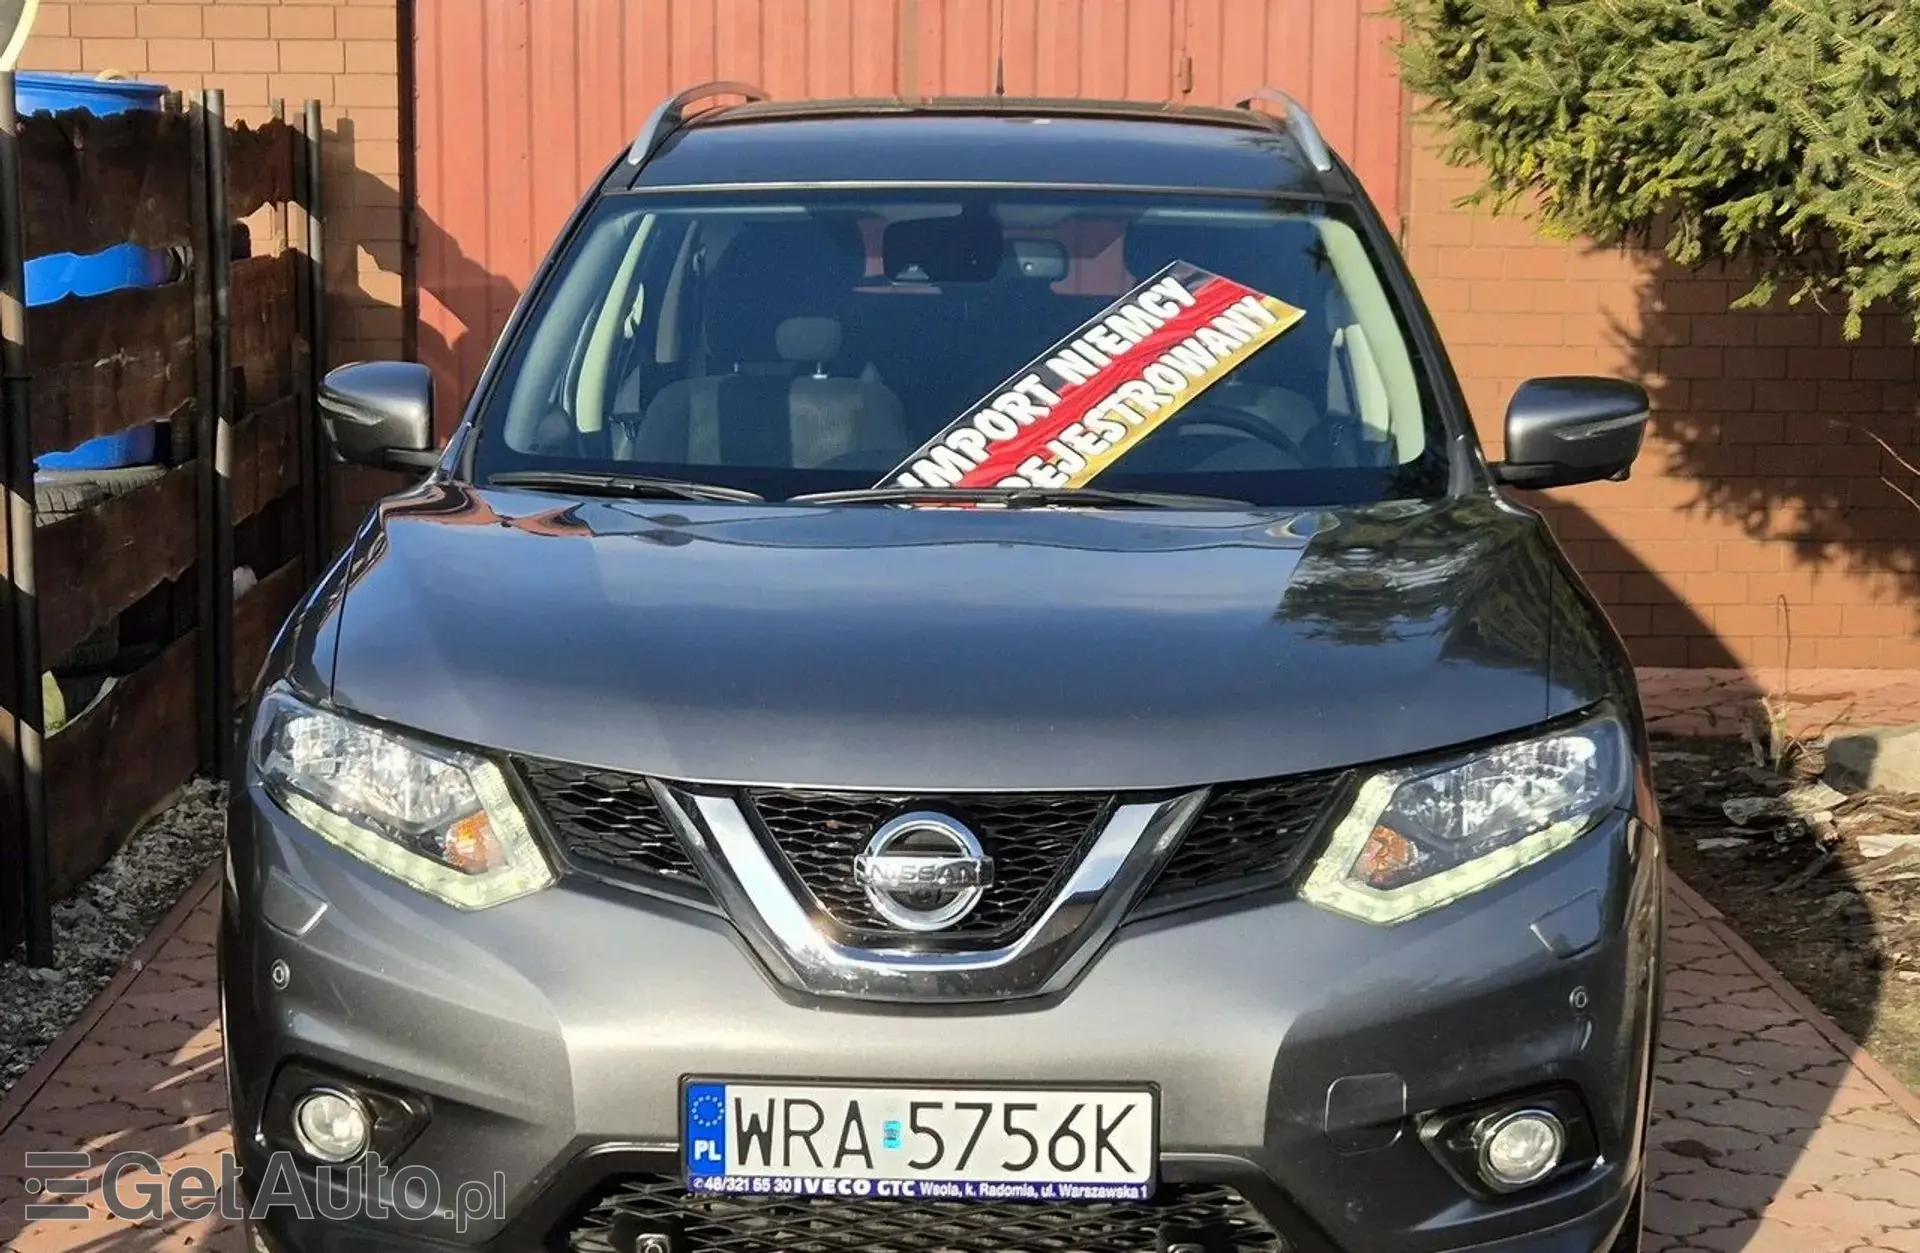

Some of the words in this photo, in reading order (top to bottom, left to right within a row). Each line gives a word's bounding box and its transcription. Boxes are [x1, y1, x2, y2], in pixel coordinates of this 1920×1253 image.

[1046, 277, 1197, 384] NIEMCY
[997, 296, 1280, 488] EJESTROWANY
[694, 1140, 721, 1161] PL
[733, 1096, 874, 1170] WRA
[907, 1101, 1137, 1173] 5756K
[773, 1178, 792, 1193] 30
[793, 1178, 871, 1195] IVECO
[877, 1179, 916, 1196] GTC
[965, 1183, 977, 1197] k.
[980, 1183, 1039, 1198] Radomia,
[1041, 1184, 1056, 1197] ul.
[1059, 1184, 1138, 1199] Warszawska
[1140, 1185, 1147, 1198] 1
